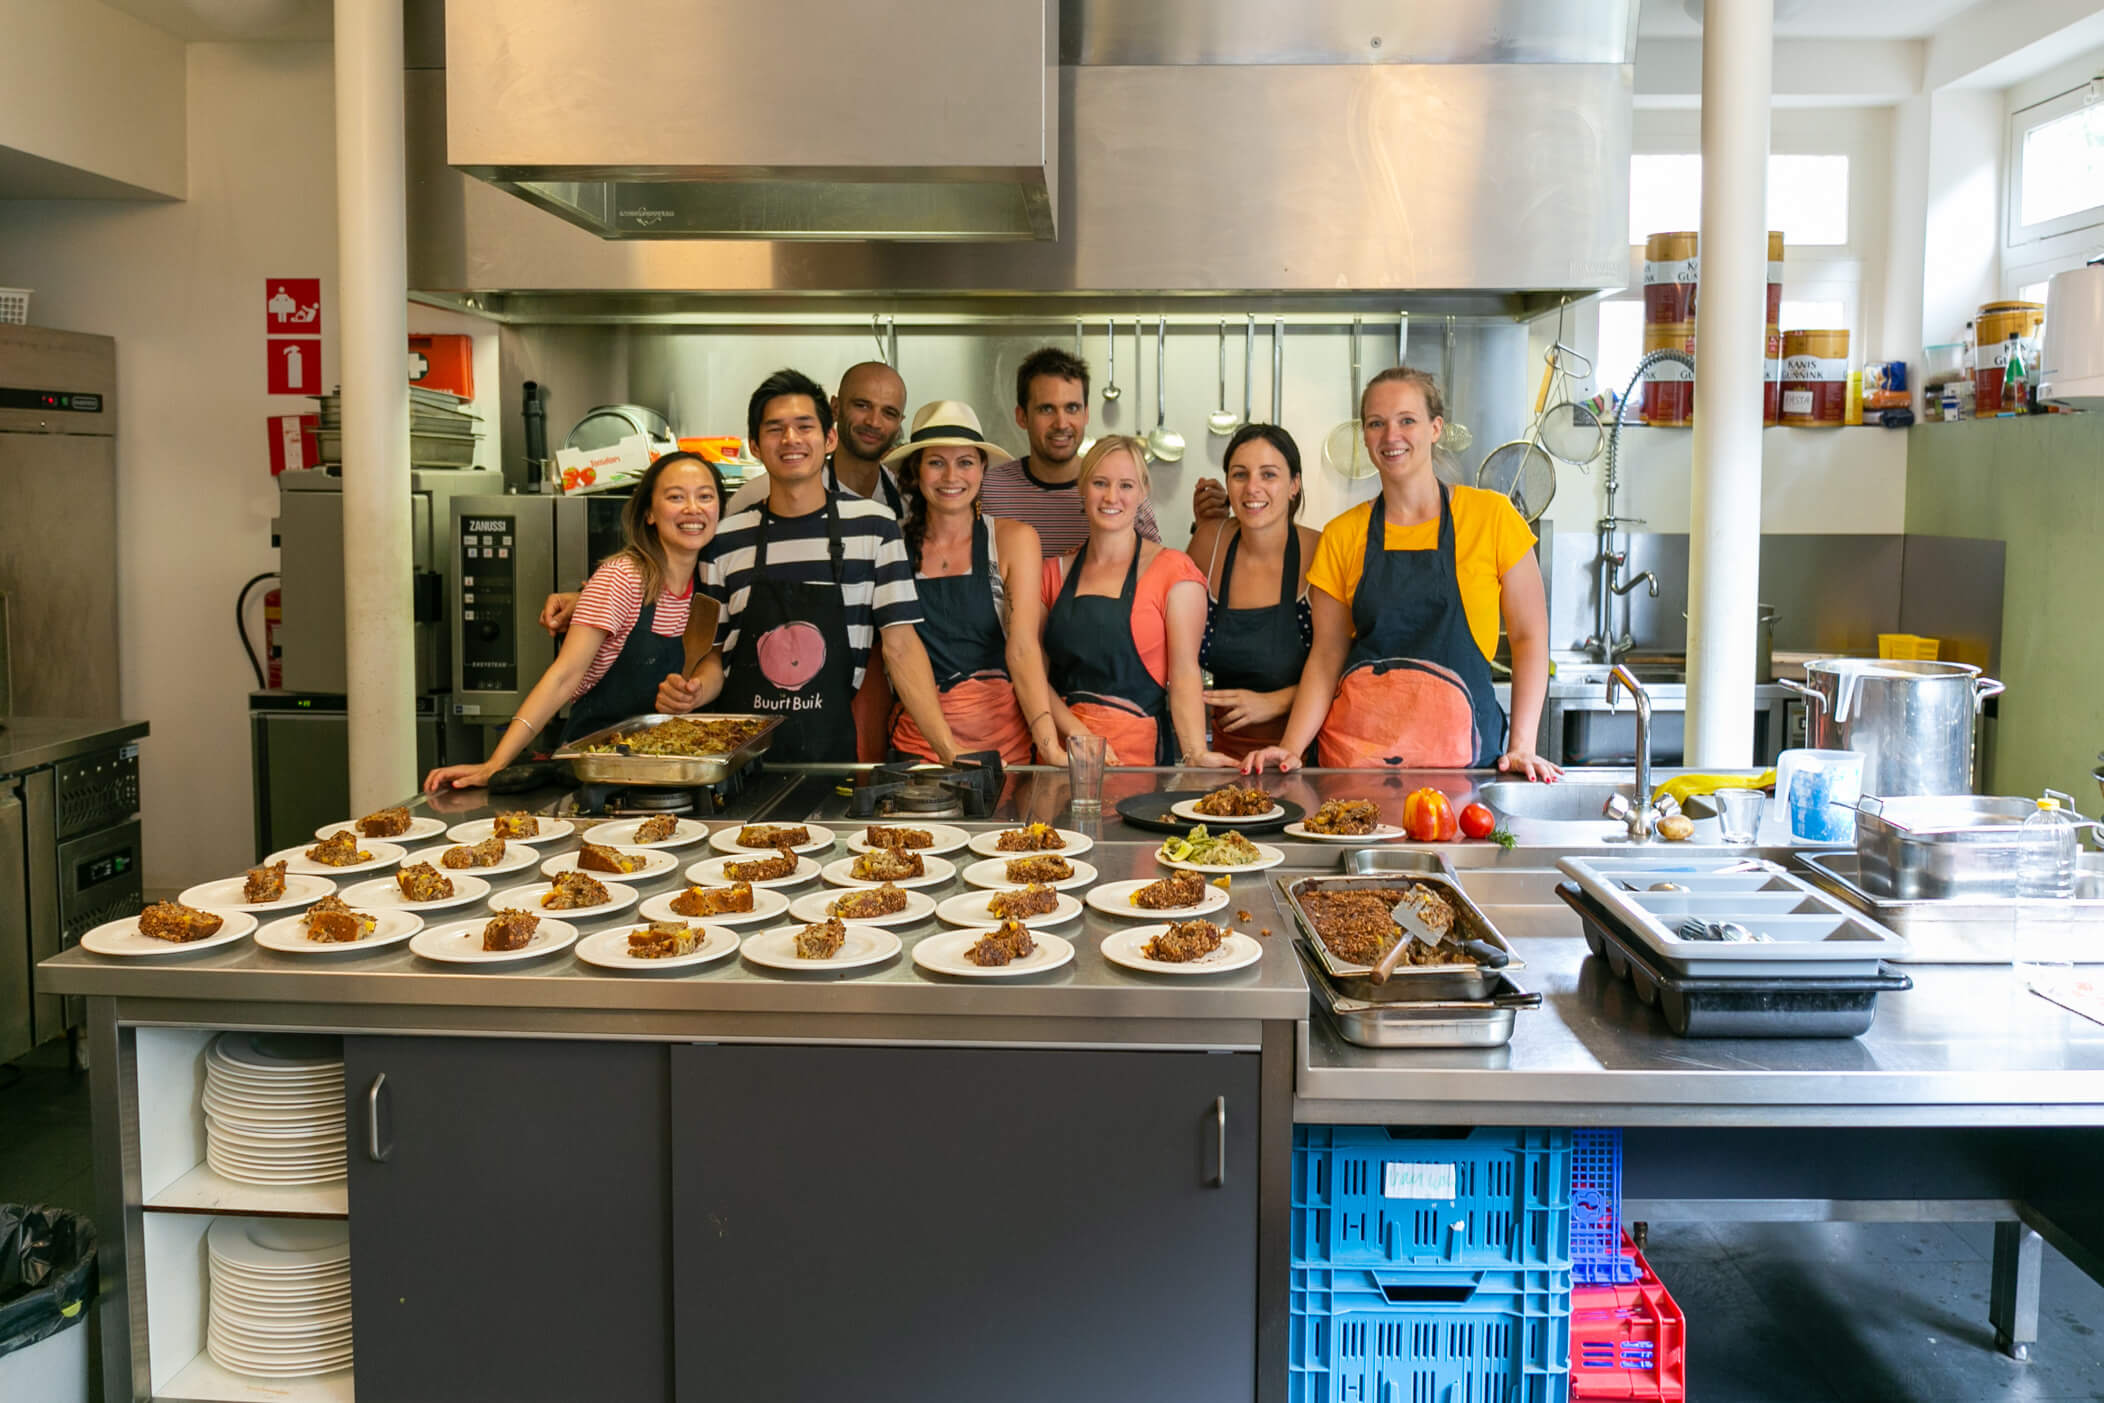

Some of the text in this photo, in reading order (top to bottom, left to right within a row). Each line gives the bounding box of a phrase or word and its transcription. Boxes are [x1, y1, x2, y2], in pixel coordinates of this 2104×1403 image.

[1787, 360, 1817, 369] KANIS
[1782, 370, 1824, 379] GUNNINK
[469, 520, 507, 532] ZANUSSI
[753, 692, 823, 711] BuurtBuik
